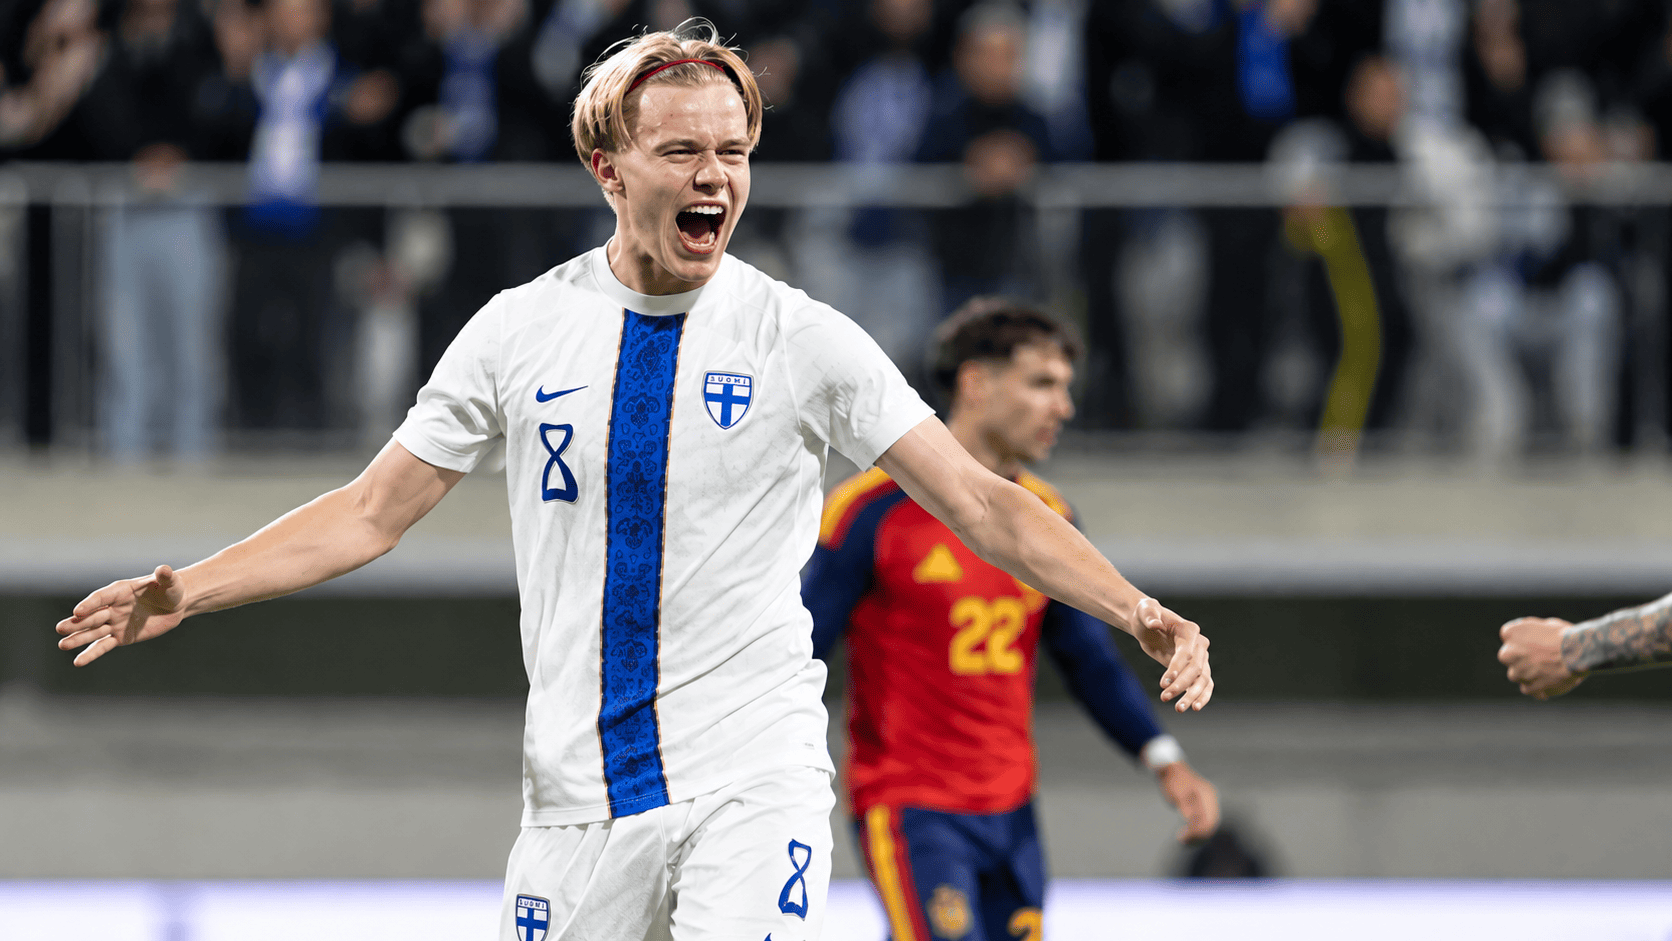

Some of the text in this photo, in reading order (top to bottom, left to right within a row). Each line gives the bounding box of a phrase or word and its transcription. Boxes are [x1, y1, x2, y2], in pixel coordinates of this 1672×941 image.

[539, 422, 579, 504] 8
[949, 595, 1024, 675] 22
[778, 838, 812, 921] 8
